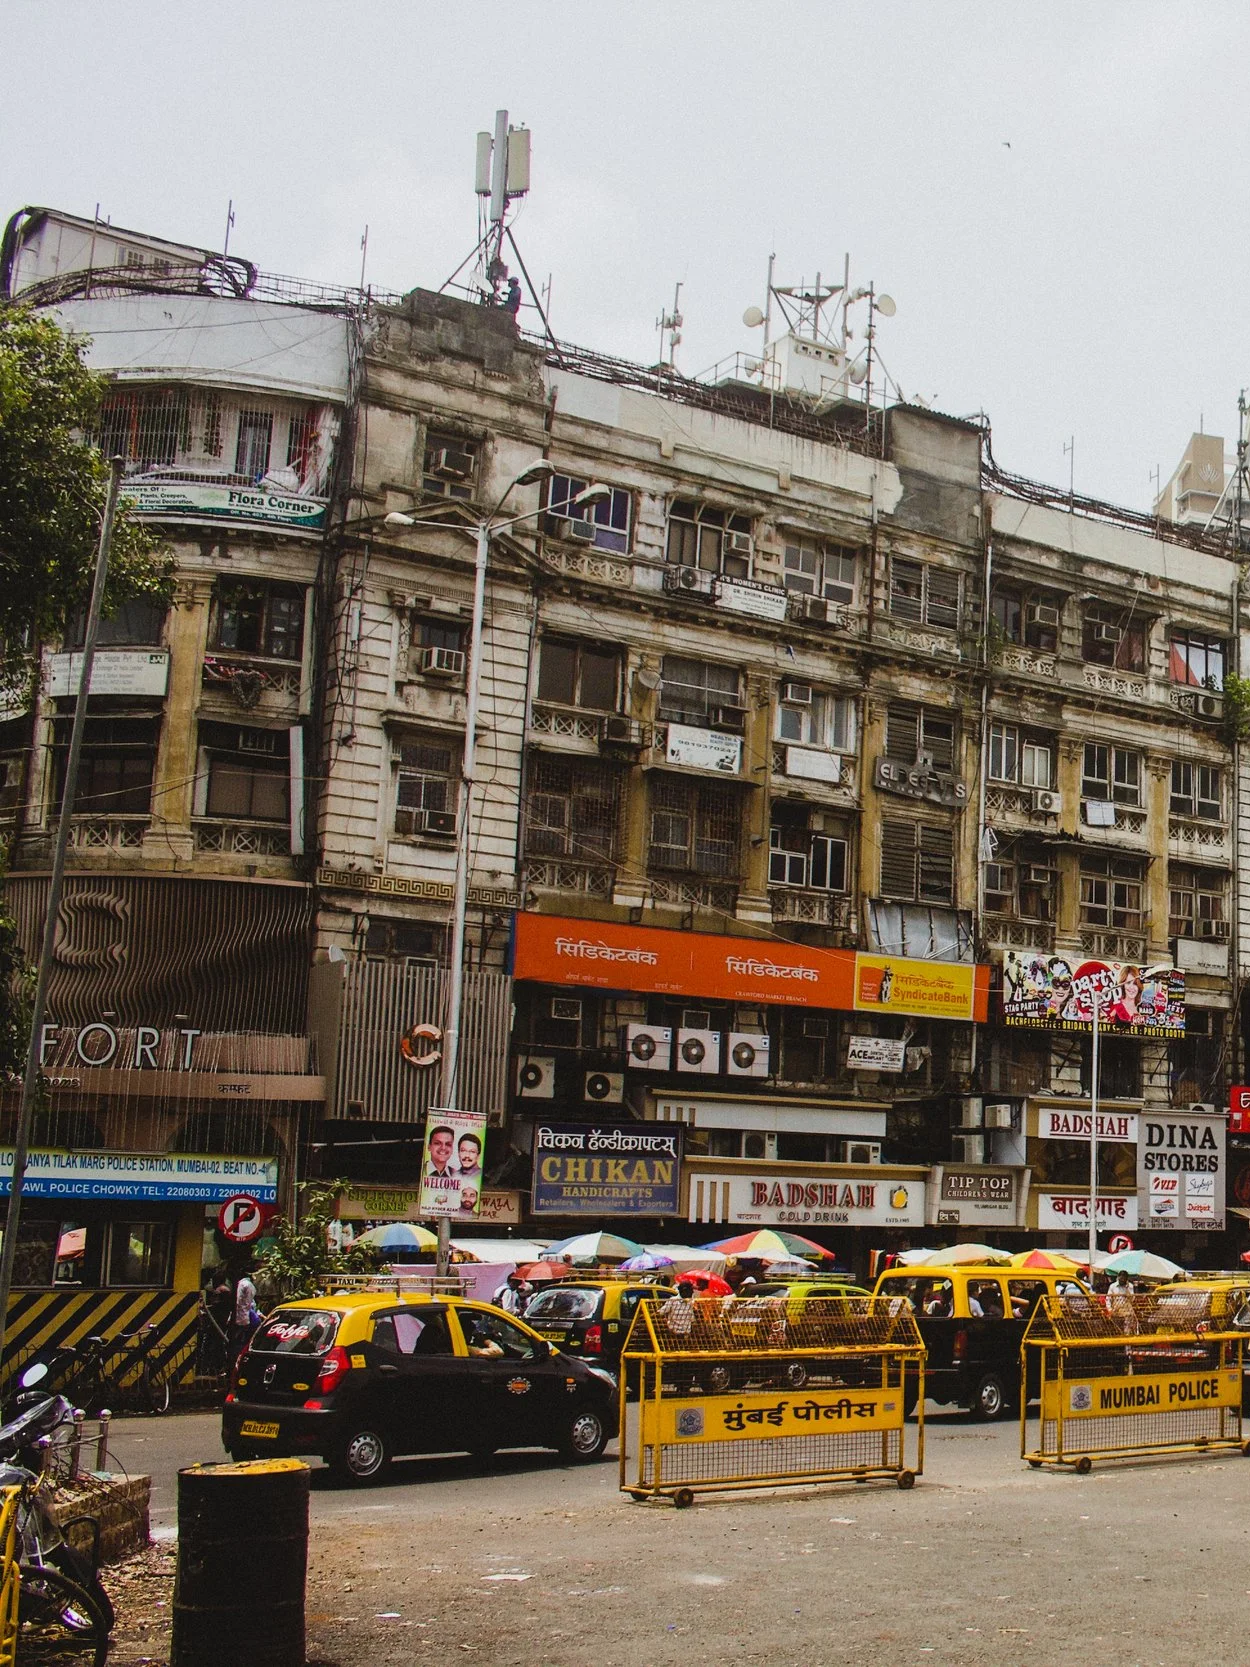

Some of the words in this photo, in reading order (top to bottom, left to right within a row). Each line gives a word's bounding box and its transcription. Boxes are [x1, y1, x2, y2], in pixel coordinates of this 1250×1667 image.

[228, 491, 265, 506] Flora
[268, 496, 315, 514] Corner
[763, 584, 786, 596] CLINIC
[1069, 966, 1122, 996] party
[893, 987, 970, 1005] SyndicateBank
[1004, 1002, 1020, 1013] STAG
[1020, 1001, 1039, 1011] PARTY
[1062, 1020, 1087, 1031] BRIDAL
[1143, 1027, 1164, 1037] PHOTO
[1164, 1028, 1186, 1039] BOOTH
[849, 1049, 869, 1060] ACE
[1050, 1113, 1129, 1136] BADSHAH
[537, 1127, 586, 1149] चिकन
[1145, 1123, 1219, 1150] DINA
[1, 1151, 51, 1168] LOANYA
[53, 1154, 78, 1170] TILAK
[79, 1155, 105, 1170] MARG
[107, 1156, 138, 1171] POLICE
[139, 1158, 175, 1174] STATION,
[223, 1161, 244, 1174] BEAT
[1144, 1151, 1219, 1173] STORES
[540, 1156, 674, 1185] CHIKAN
[423, 1176, 461, 1191] WELCOME
[948, 1176, 975, 1188] TIP
[979, 1177, 1010, 1190] TOP
[1160, 1179, 1178, 1191] VIP
[49, 1184, 90, 1194] POLICE
[92, 1185, 140, 1195] CHOWKY
[142, 1186, 165, 1196] TEL:
[166, 1187, 211, 1198] 22080303
[349, 1190, 418, 1202] SELECTIO
[561, 1186, 654, 1199] HANDICRAFTS
[751, 1181, 877, 1209] BADSHAH
[947, 1190, 988, 1199] CHILDREN'S
[990, 1191, 1009, 1199] WEAR
[363, 1201, 409, 1213] CORNER
[637, 1201, 674, 1210] Exporters
[777, 1210, 812, 1223] COLD
[813, 1211, 849, 1224] DRINK
[337, 1277, 356, 1287] TAXI
[1100, 1384, 1160, 1410] MUMBAI
[1168, 1378, 1219, 1404] POLICE
[722, 1401, 790, 1431] मुंबई
[792, 1399, 878, 1422] पोलीस
